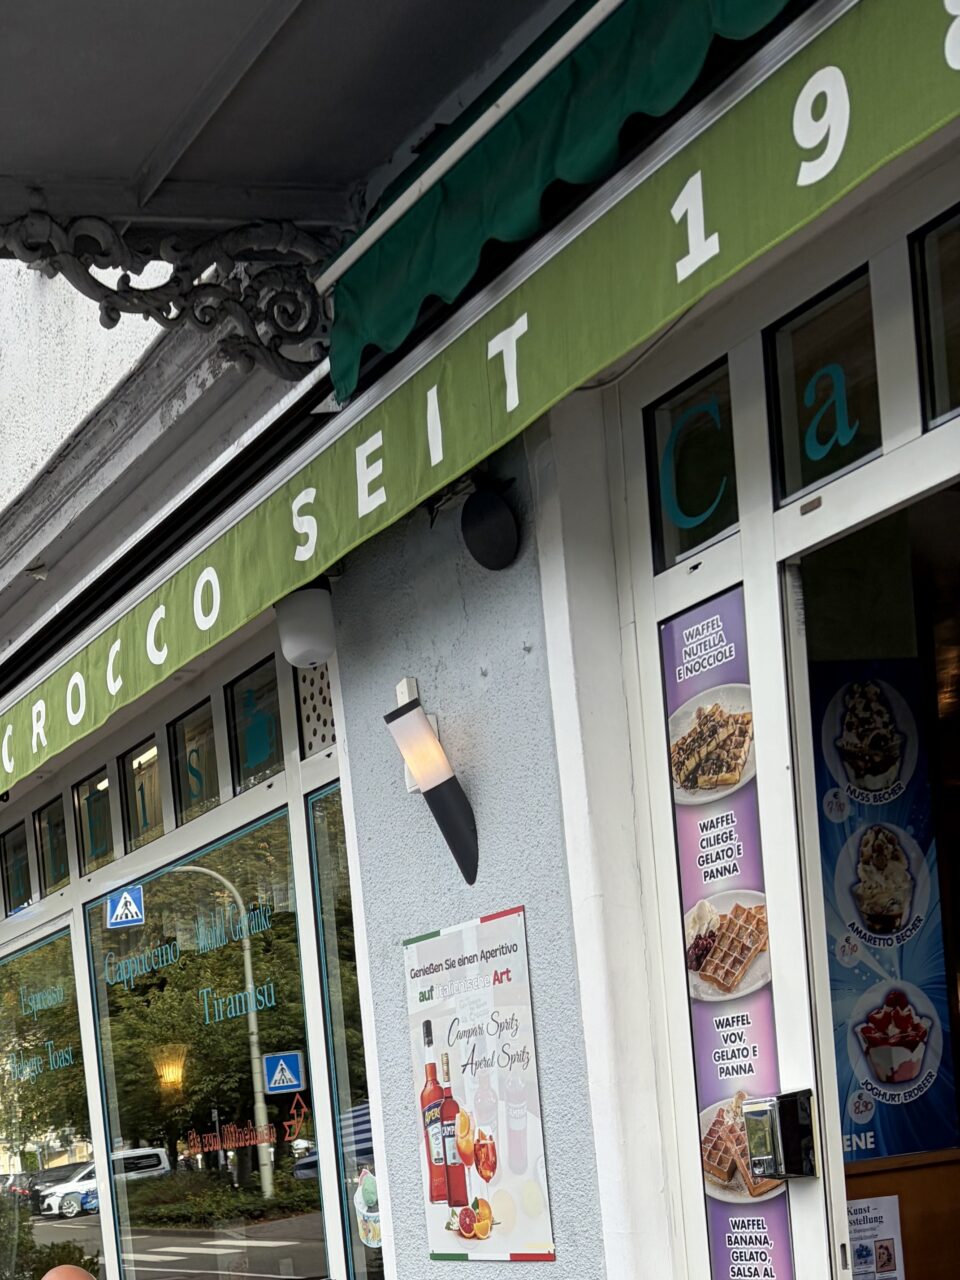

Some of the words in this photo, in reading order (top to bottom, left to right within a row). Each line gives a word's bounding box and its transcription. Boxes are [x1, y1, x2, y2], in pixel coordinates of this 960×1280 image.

[1, 566, 221, 774] CROCCO
[291, 311, 529, 562] SEIT
[684, 617, 722, 642] WAFFEL
[683, 633, 725, 661] NUTELLA
[677, 668, 683, 681] E
[685, 645, 734, 677] NOCCIOLE
[846, 784, 871, 803] NUSS
[872, 782, 905, 804] BECHER
[699, 812, 736, 834] WAFFEL
[700, 829, 738, 850] CILIEGE,
[697, 846, 734, 867] GELATO
[736, 844, 742, 856] E
[703, 862, 739, 882] PANNA
[847, 922, 894, 948] AMARETTO
[895, 915, 924, 944] BECHER
[104, 939, 180, 991] Cappuccino
[410, 962, 444, 979] Genießen
[445, 958, 457, 970] Sie
[457, 953, 478, 967] einen
[480, 943, 518, 963] Aperitivo
[419, 985, 435, 1002] auf
[493, 967, 512, 985] Art
[487, 1010, 520, 1039] Spritz
[714, 1013, 751, 1030] WAFFEL
[722, 1031, 746, 1045] VOV,
[45, 1039, 74, 1072] Toast
[497, 1043, 530, 1071] Spritz
[713, 1046, 750, 1062] GELATO
[752, 1045, 758, 1057] E
[719, 1062, 755, 1077] PANNA
[861, 1079, 901, 1102] JOGHURT
[903, 1071, 936, 1101] ERDBEER
[730, 1218, 767, 1230] WAFFEL
[727, 1235, 774, 1248] BANANA,
[731, 1251, 771, 1263] GELATO,
[730, 1266, 760, 1278] SALSA
[763, 1267, 775, 1278] AL
